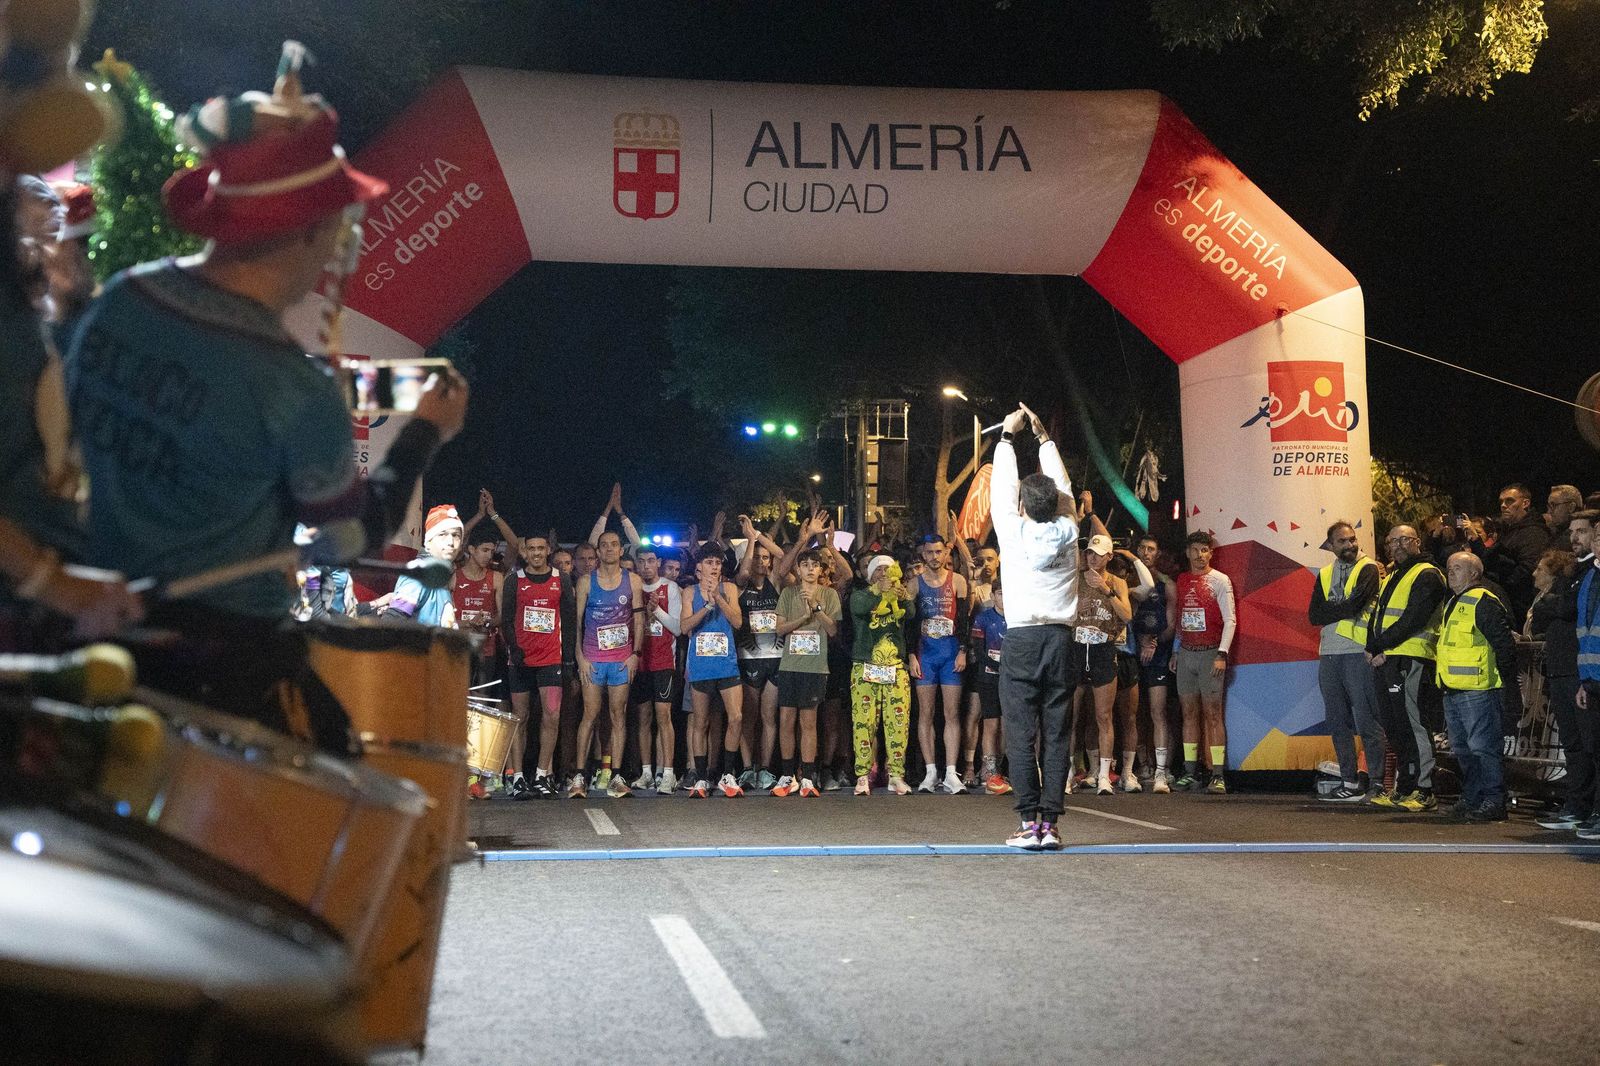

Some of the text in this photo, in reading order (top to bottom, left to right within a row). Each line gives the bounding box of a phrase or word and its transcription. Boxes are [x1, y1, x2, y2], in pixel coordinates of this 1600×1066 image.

[745, 115, 1031, 172] ALMERÍA
[743, 181, 889, 214] CIUDAD
[365, 182, 484, 291] es deporte
[1154, 198, 1268, 301] es deporte
[1173, 175, 1287, 280] ALMERÍA
[1273, 452, 1349, 464] DEPORTES
[1273, 465, 1350, 476] DE ALMERIA
